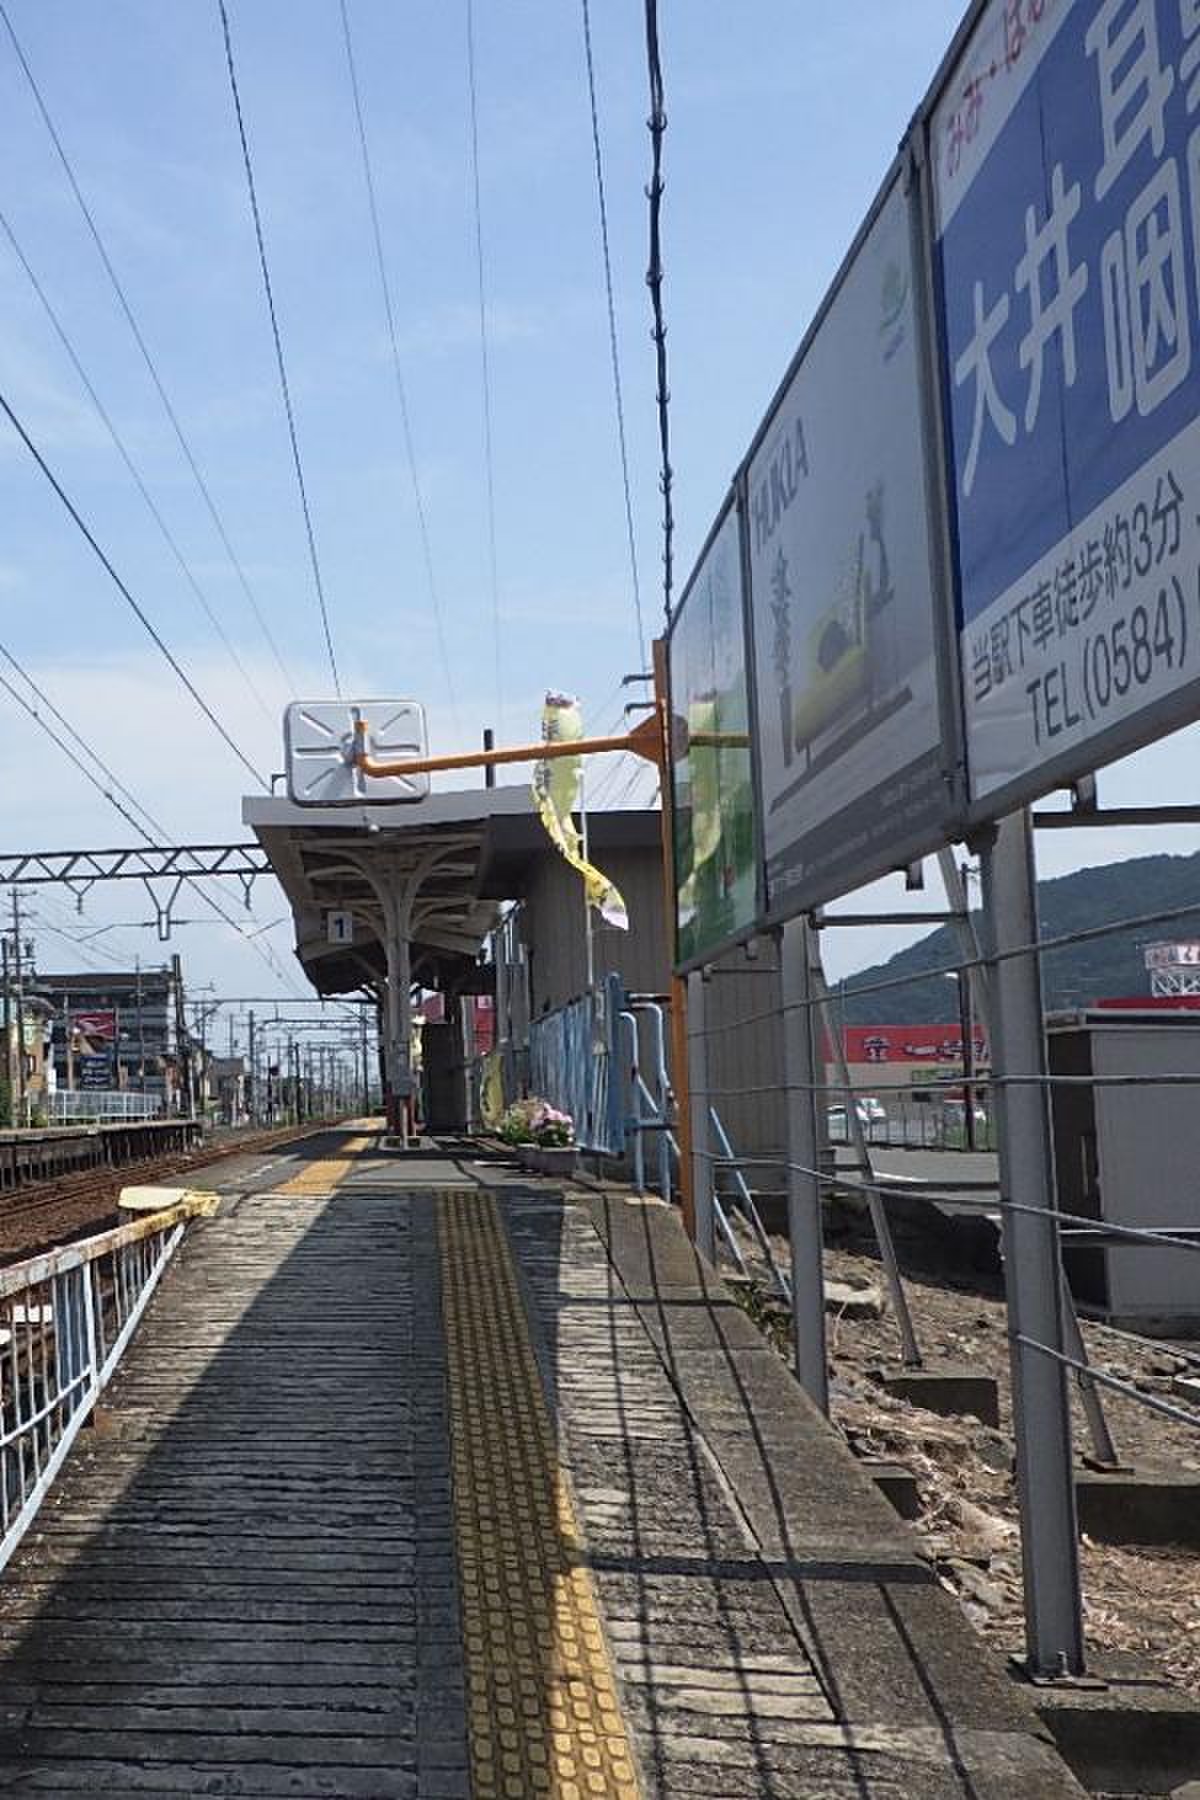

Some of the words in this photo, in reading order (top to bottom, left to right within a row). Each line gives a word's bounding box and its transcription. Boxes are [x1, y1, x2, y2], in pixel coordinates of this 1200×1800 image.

[955, 162, 1090, 497] 大井
[1102, 125, 1200, 422] 咽
[334, 918, 345, 939] 1
